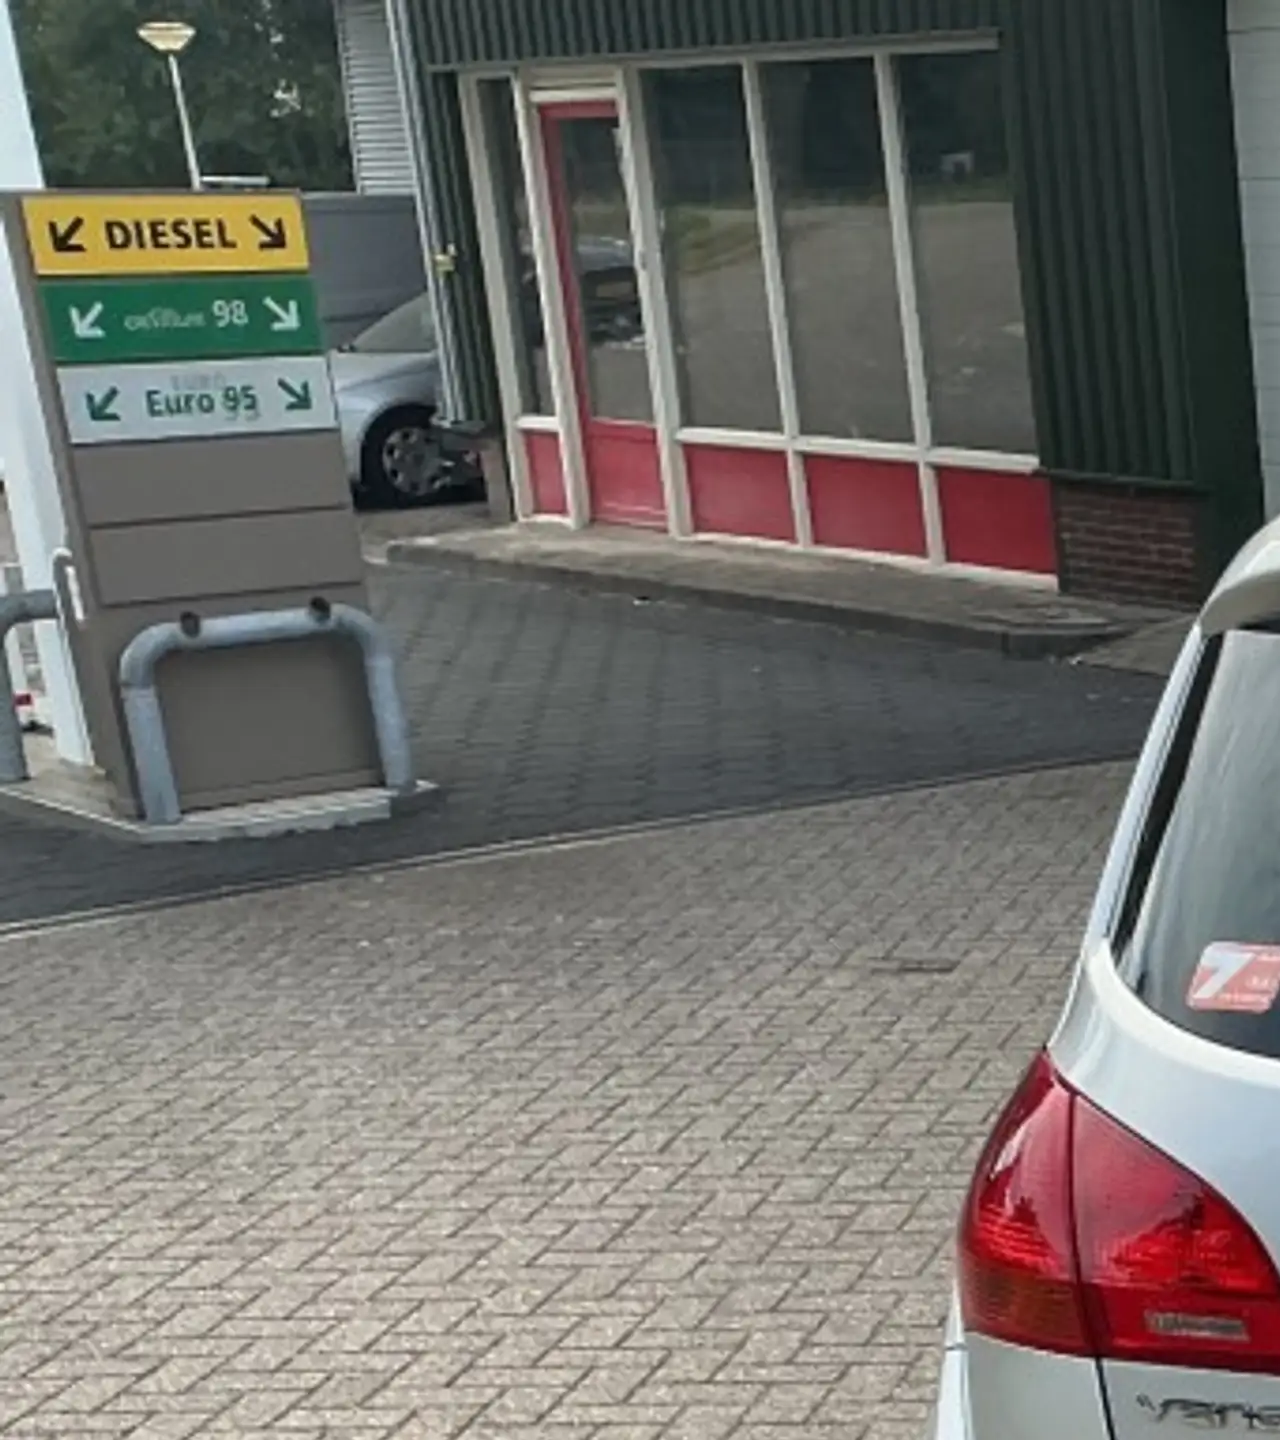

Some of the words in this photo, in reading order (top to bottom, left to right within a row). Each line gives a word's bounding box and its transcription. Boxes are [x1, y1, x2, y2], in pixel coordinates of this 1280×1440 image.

[104, 218, 238, 250] DIESEL
[212, 299, 249, 328] 98
[146, 388, 215, 418] Euro
[221, 385, 258, 412] 95
